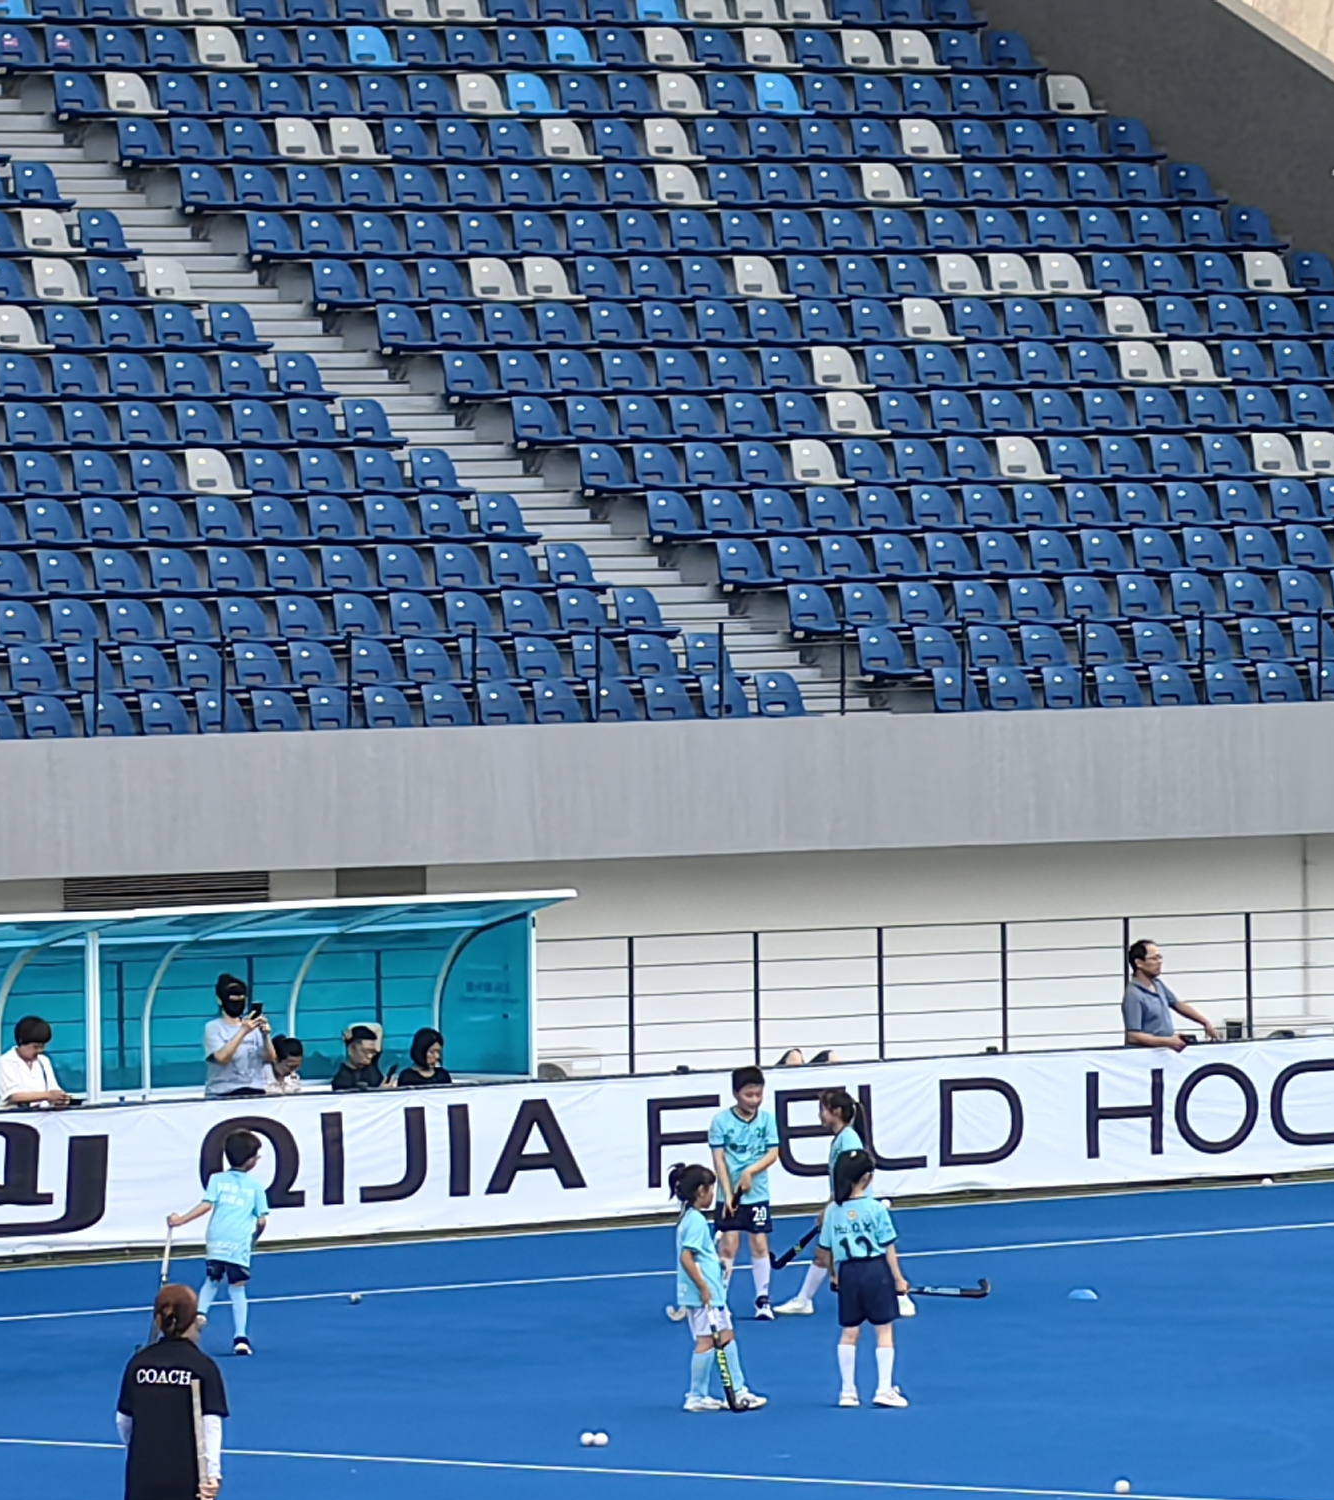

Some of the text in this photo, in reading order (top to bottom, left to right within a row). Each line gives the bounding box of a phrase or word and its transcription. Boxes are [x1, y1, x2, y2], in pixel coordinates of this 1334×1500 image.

[199, 1098, 588, 1210] QIJIA
[646, 1077, 1024, 1189] FELD
[136, 1369, 192, 1385] COACH
